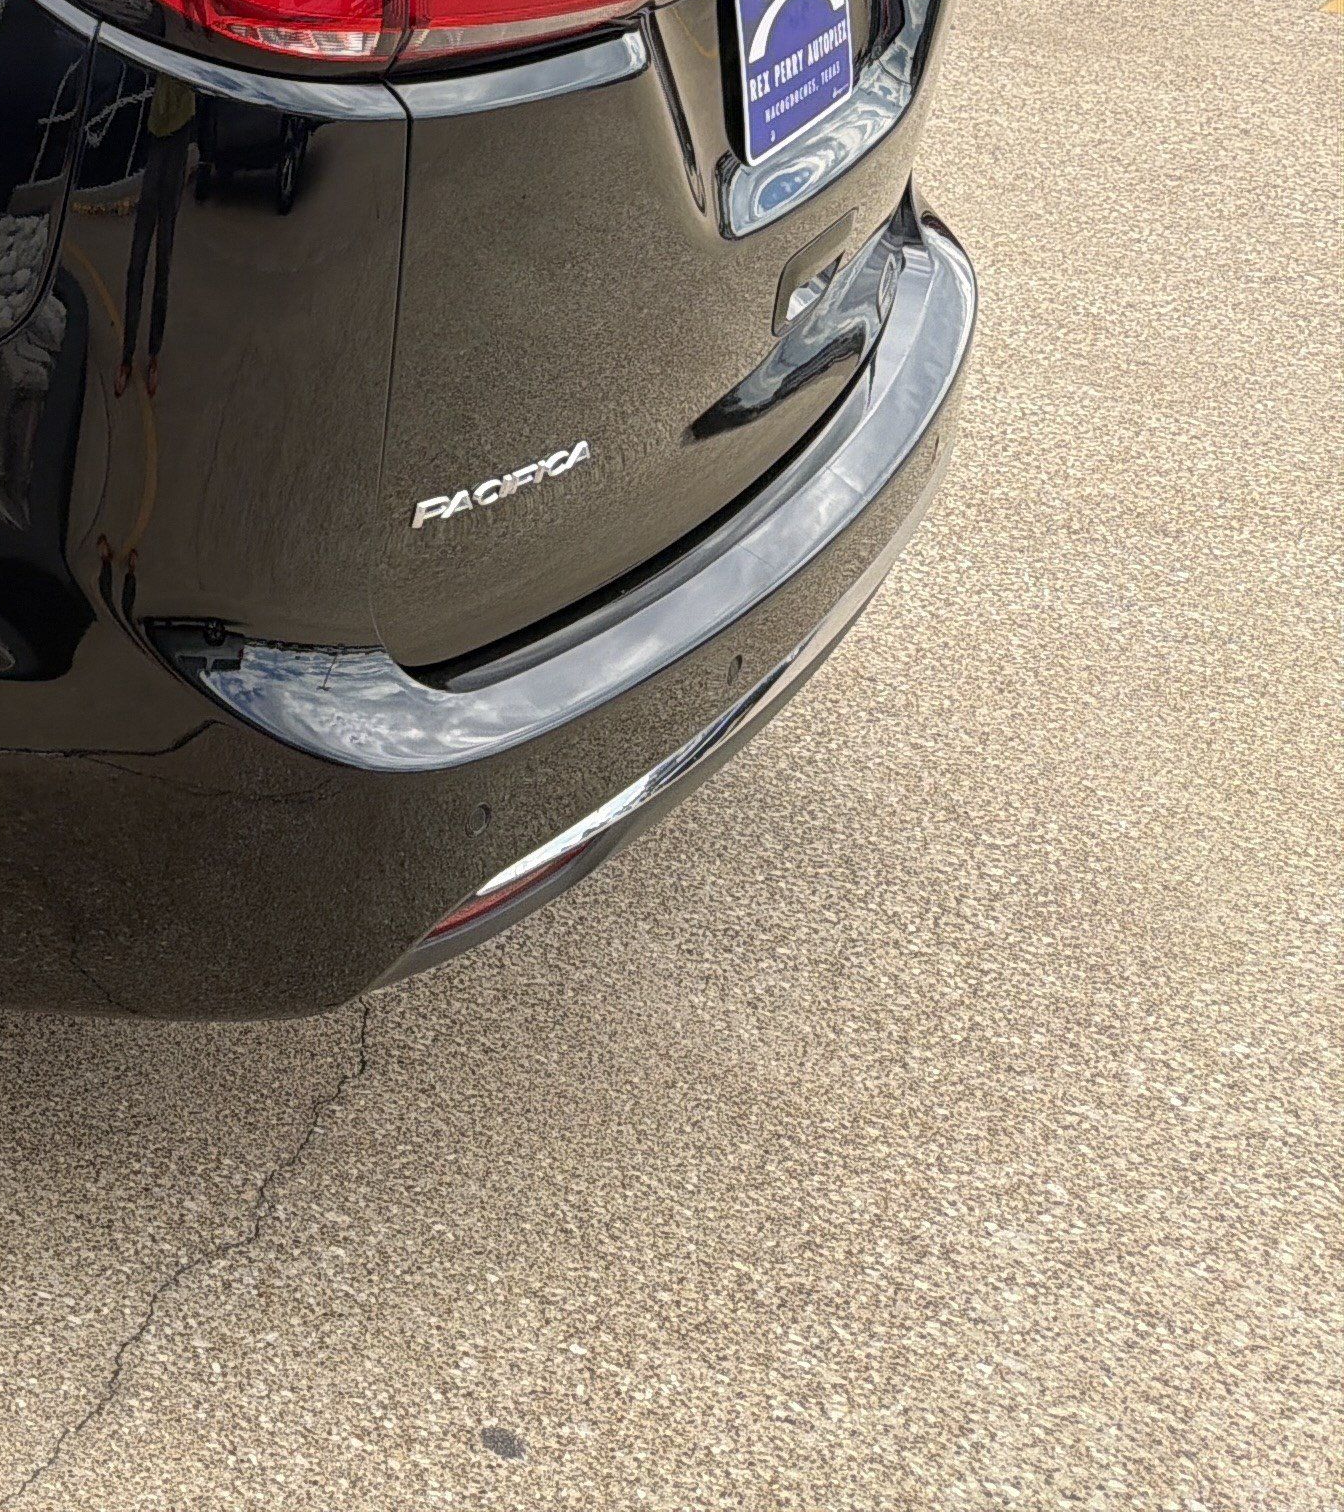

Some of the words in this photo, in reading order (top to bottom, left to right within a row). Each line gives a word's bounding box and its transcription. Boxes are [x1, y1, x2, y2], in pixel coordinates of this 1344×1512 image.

[749, 70, 770, 102] REX
[774, 49, 803, 87] PERRY
[807, 18, 847, 66] AUTOPLEX
[411, 440, 590, 529] PACIFICA
